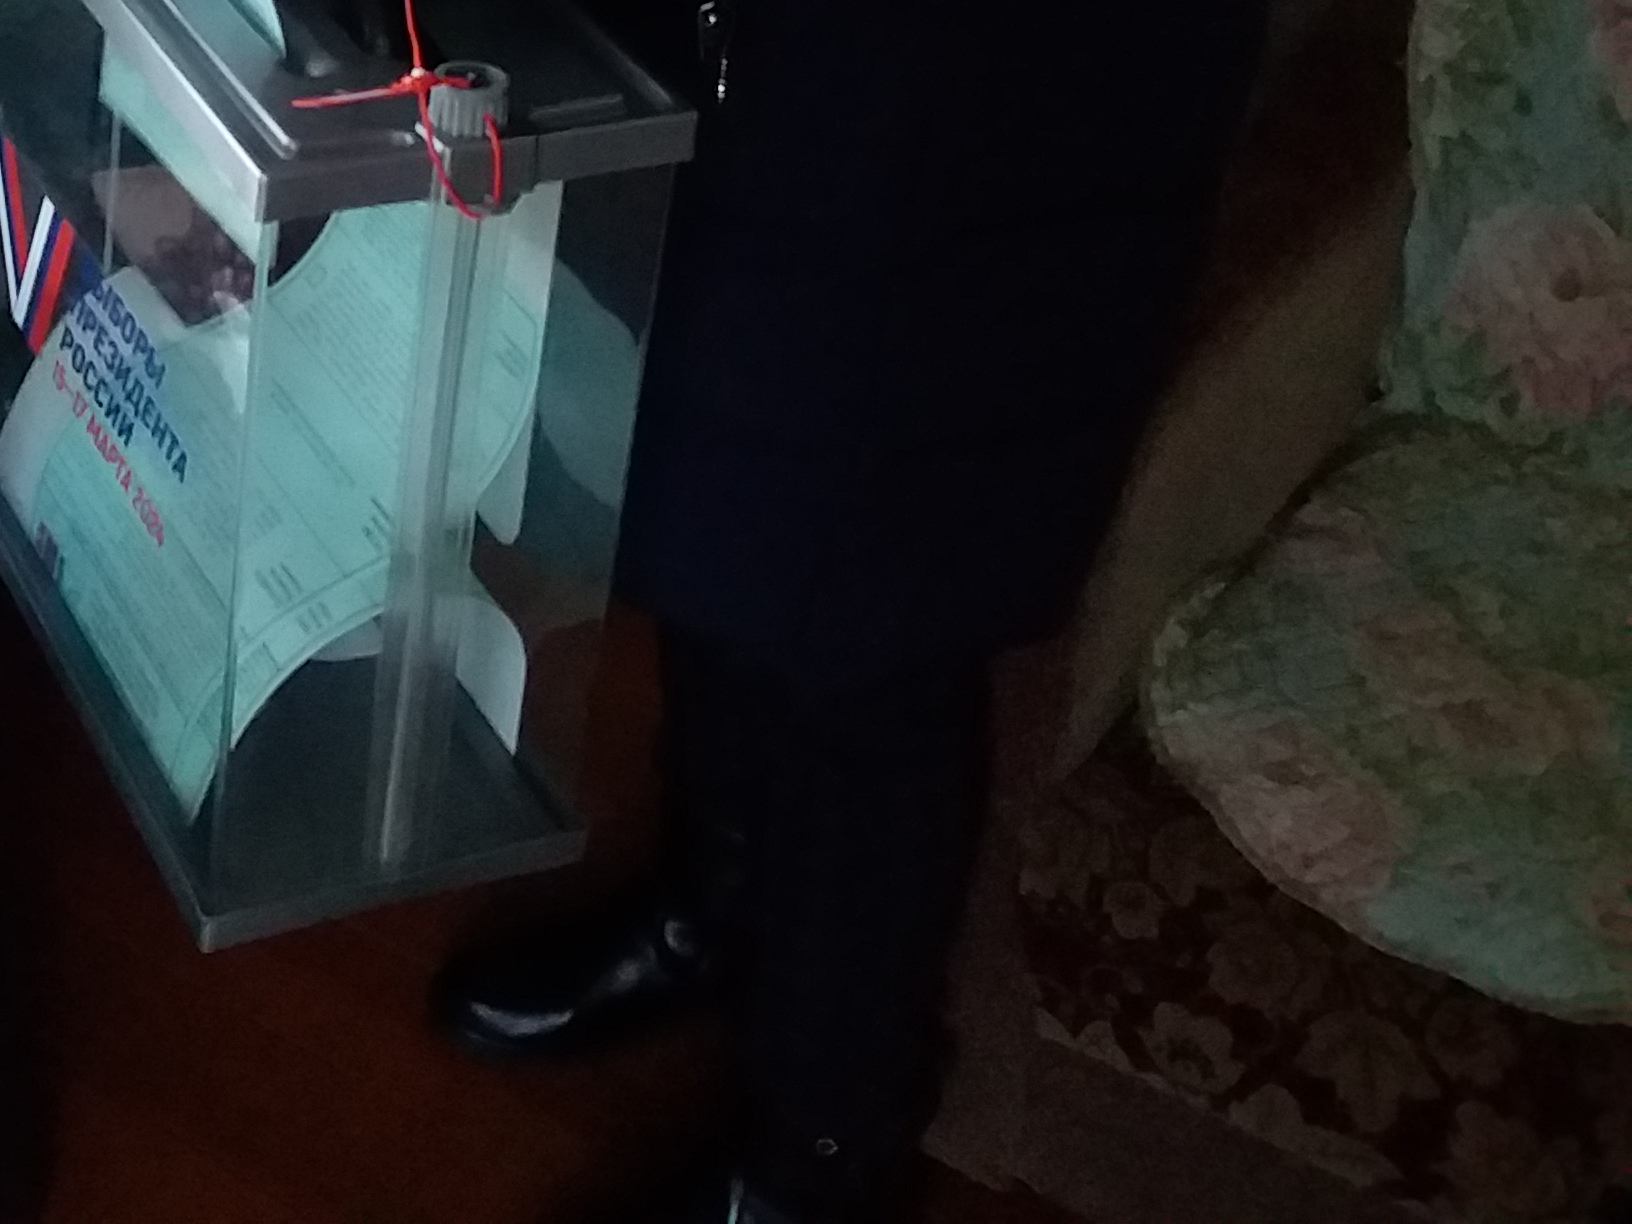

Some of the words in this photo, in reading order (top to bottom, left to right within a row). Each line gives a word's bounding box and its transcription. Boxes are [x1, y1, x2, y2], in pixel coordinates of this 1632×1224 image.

[60, 325, 134, 448] РОССИИ
[81, 268, 165, 389] ЫБОРЫ
[86, 411, 132, 493] МАРТА
